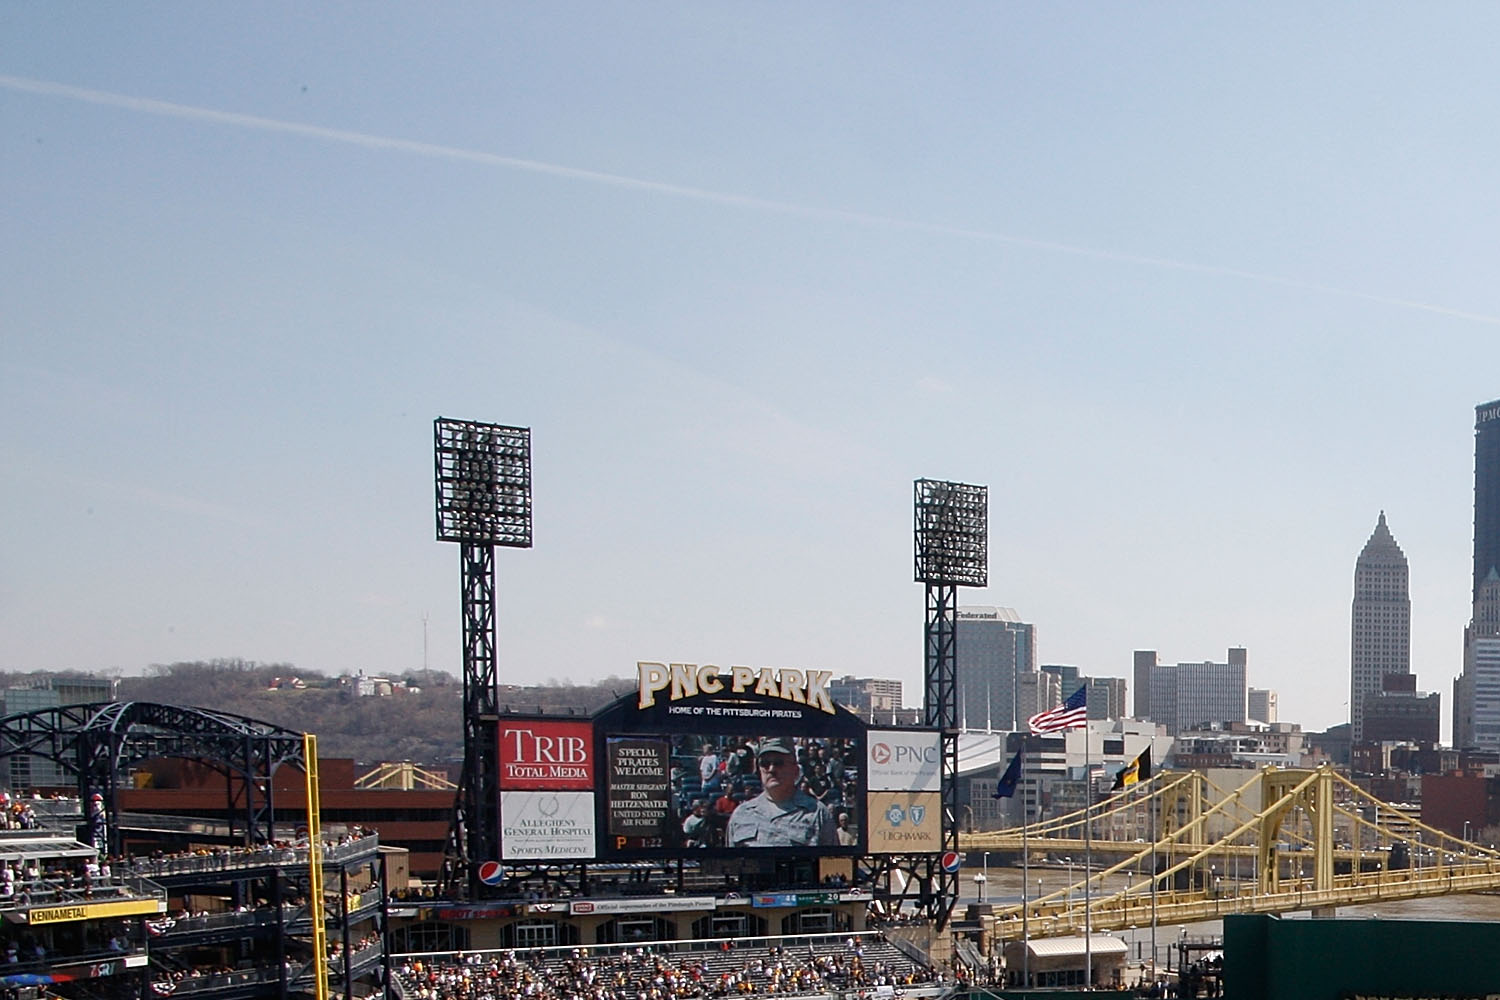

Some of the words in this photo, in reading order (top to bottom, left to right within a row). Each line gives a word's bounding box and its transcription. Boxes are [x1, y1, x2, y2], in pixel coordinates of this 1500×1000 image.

[956, 611, 997, 619] Federated
[638, 661, 725, 710] PNC
[731, 666, 836, 715] PARK
[669, 706, 692, 715] HOME
[693, 707, 704, 715] OF
[706, 707, 721, 716] THE
[723, 708, 770, 718] PITTSBURGH
[771, 709, 802, 718] PIRATES
[504, 729, 587, 763] TRIB
[619, 748, 657, 757] SPECIAL
[895, 745, 936, 763] PNC
[617, 758, 659, 767] PIRATES
[506, 764, 548, 777] TOTAL
[549, 766, 588, 778] MEDIA
[615, 766, 664, 776] WELCOME
[630, 791, 648, 799] RON
[613, 810, 640, 818] UNITED
[642, 810, 665, 818] STATES
[520, 819, 576, 828] ALLEGHENY
[622, 818, 634, 826] AIR
[635, 818, 657, 826] FORCE
[504, 827, 549, 837] GENERAL
[551, 827, 593, 836] HOSPITAL
[511, 845, 543, 855] SPORTS
[545, 845, 587, 855] MEDICINE
[31, 907, 86, 922] KENNAMETAL
